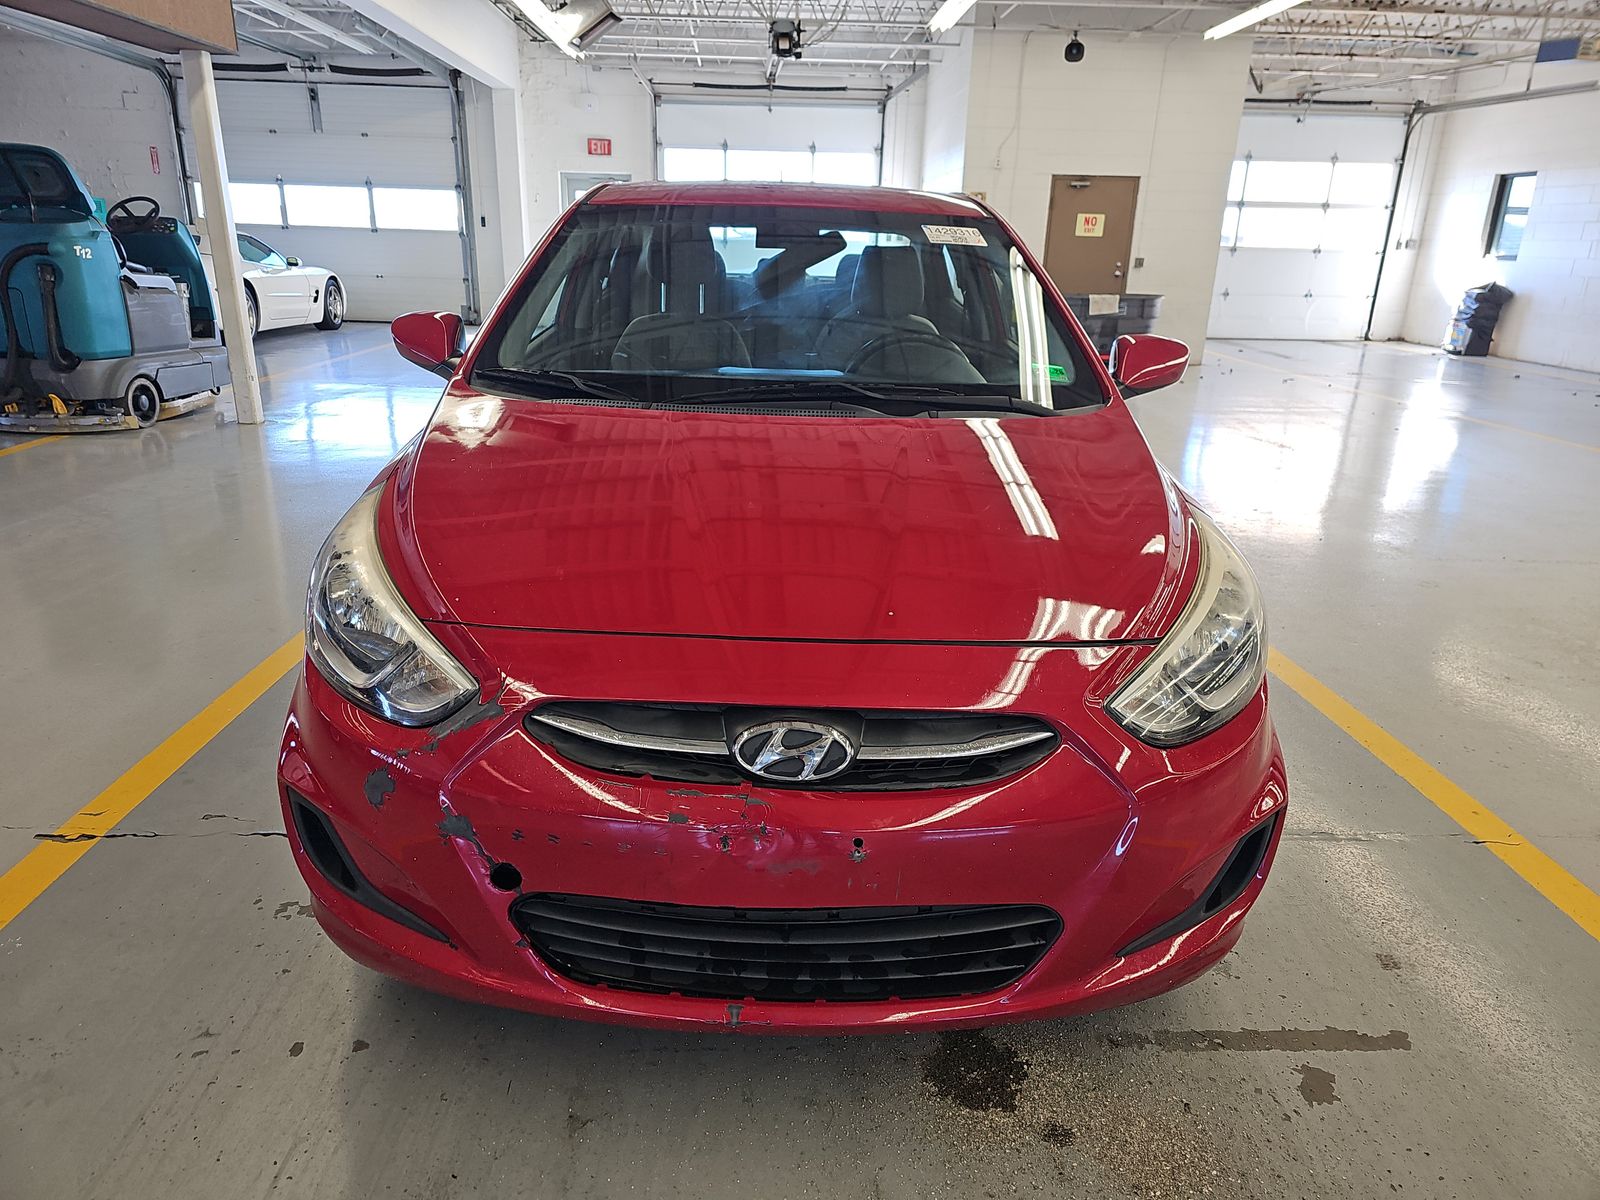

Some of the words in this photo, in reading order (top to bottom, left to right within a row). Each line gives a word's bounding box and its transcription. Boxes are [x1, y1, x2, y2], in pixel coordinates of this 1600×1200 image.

[591, 140, 609, 154] EXIT
[1084, 216, 1097, 227] NO
[73, 245, 92, 259] T12
